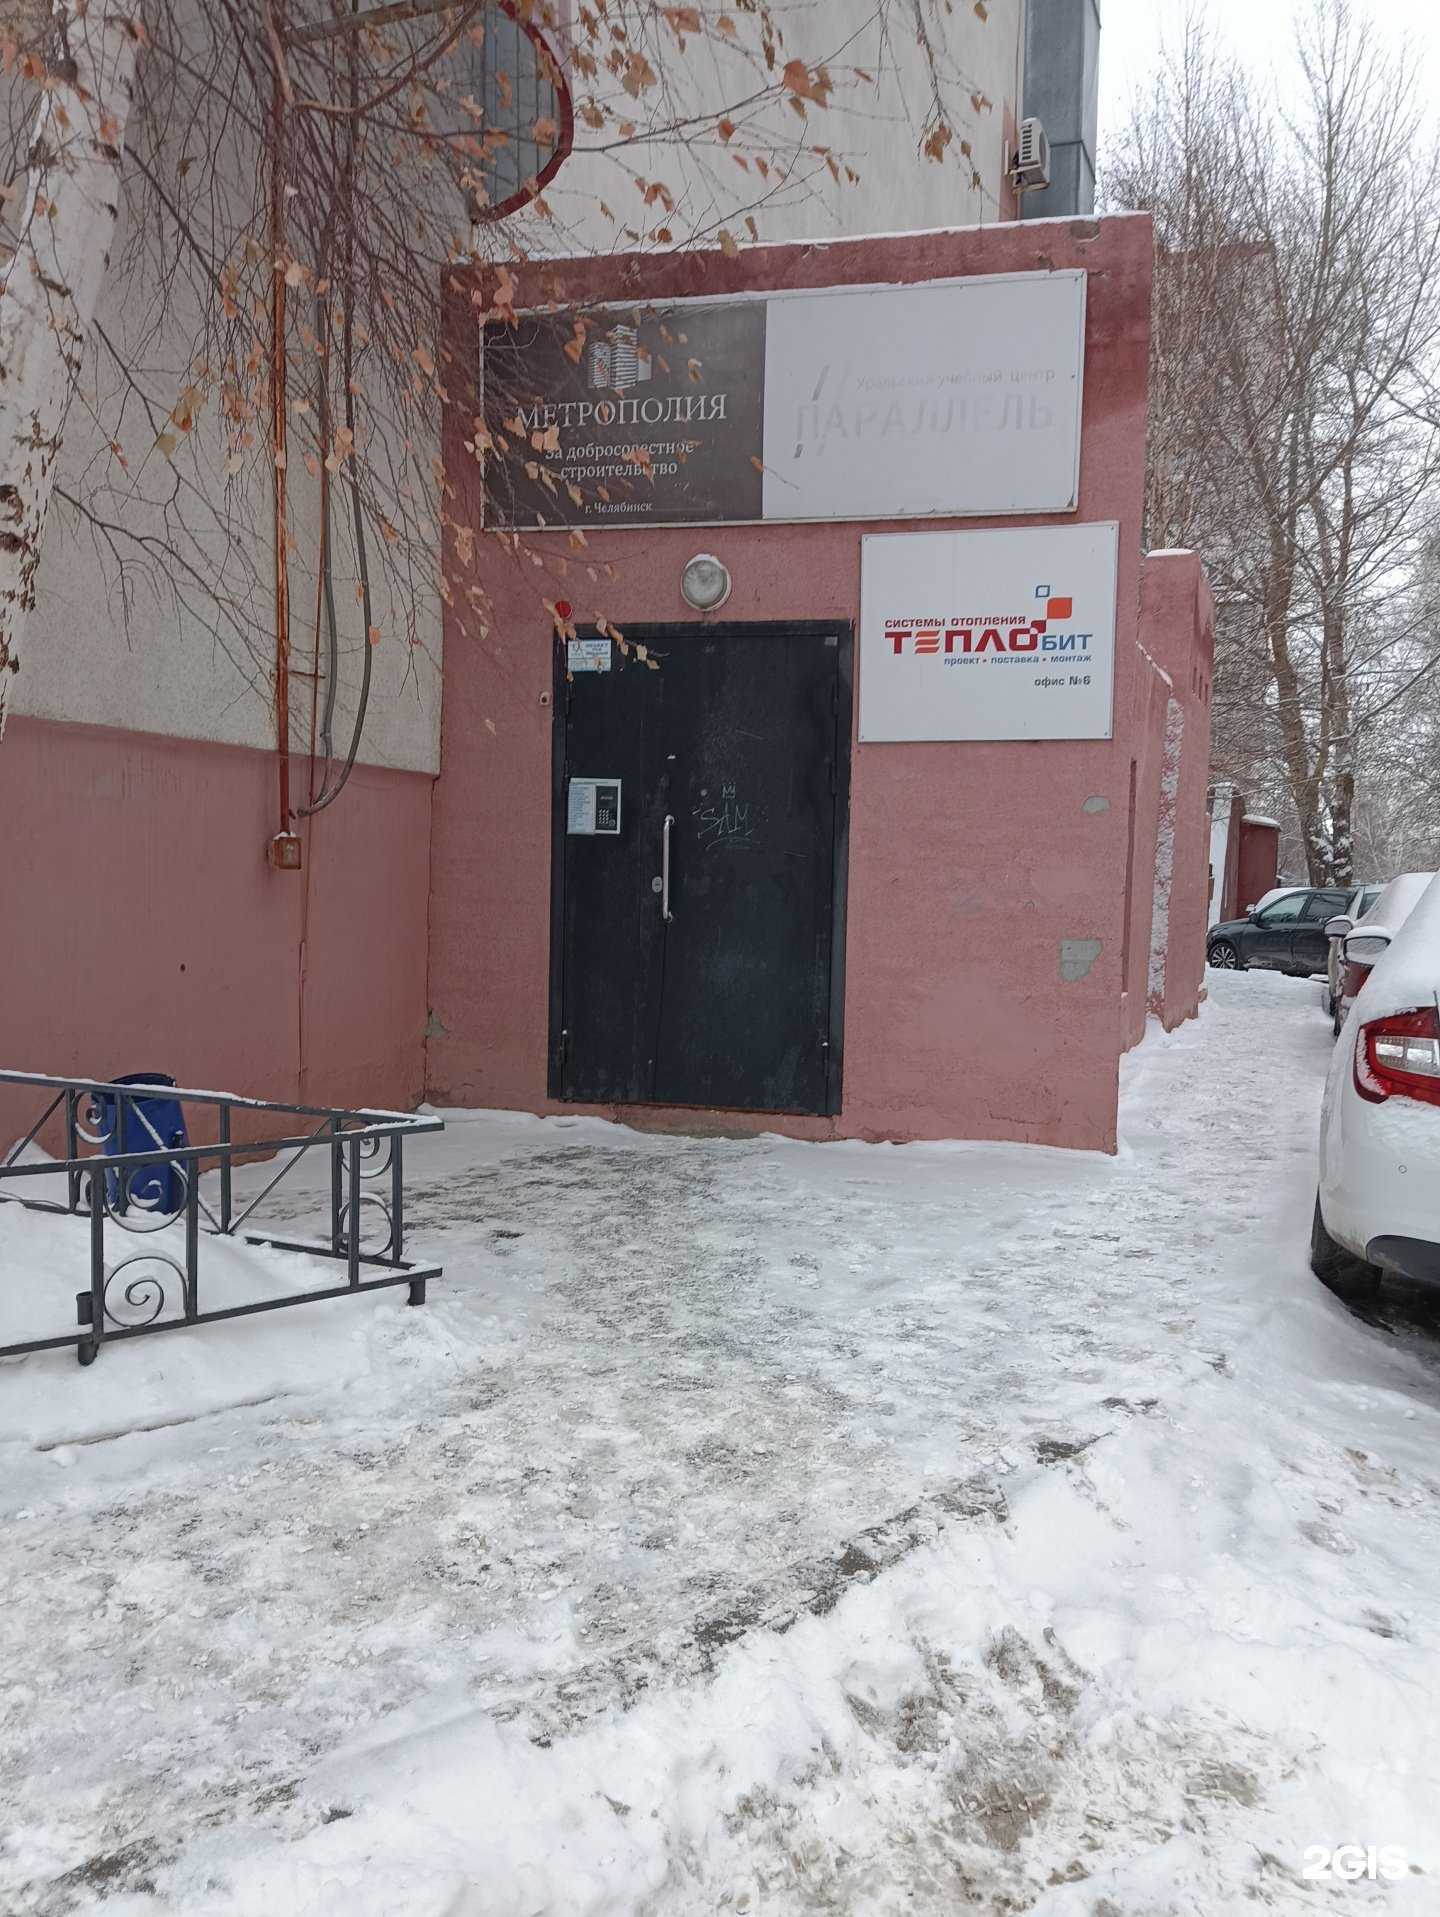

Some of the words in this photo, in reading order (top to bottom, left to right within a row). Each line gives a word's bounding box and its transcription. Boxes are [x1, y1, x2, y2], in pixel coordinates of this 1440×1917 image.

[517, 393, 728, 430] МЕТРОПОЛИЯ
[795, 392, 1057, 440] ПАРАЛЛЕЛЬ
[594, 501, 654, 514] Челябинск
[884, 617, 946, 629] системы
[950, 615, 1026, 627] отопления
[944, 656, 980, 666] проект
[990, 655, 1040, 665] поставка
[1050, 654, 1093, 664] монтаж
[1034, 675, 1066, 688] офис
